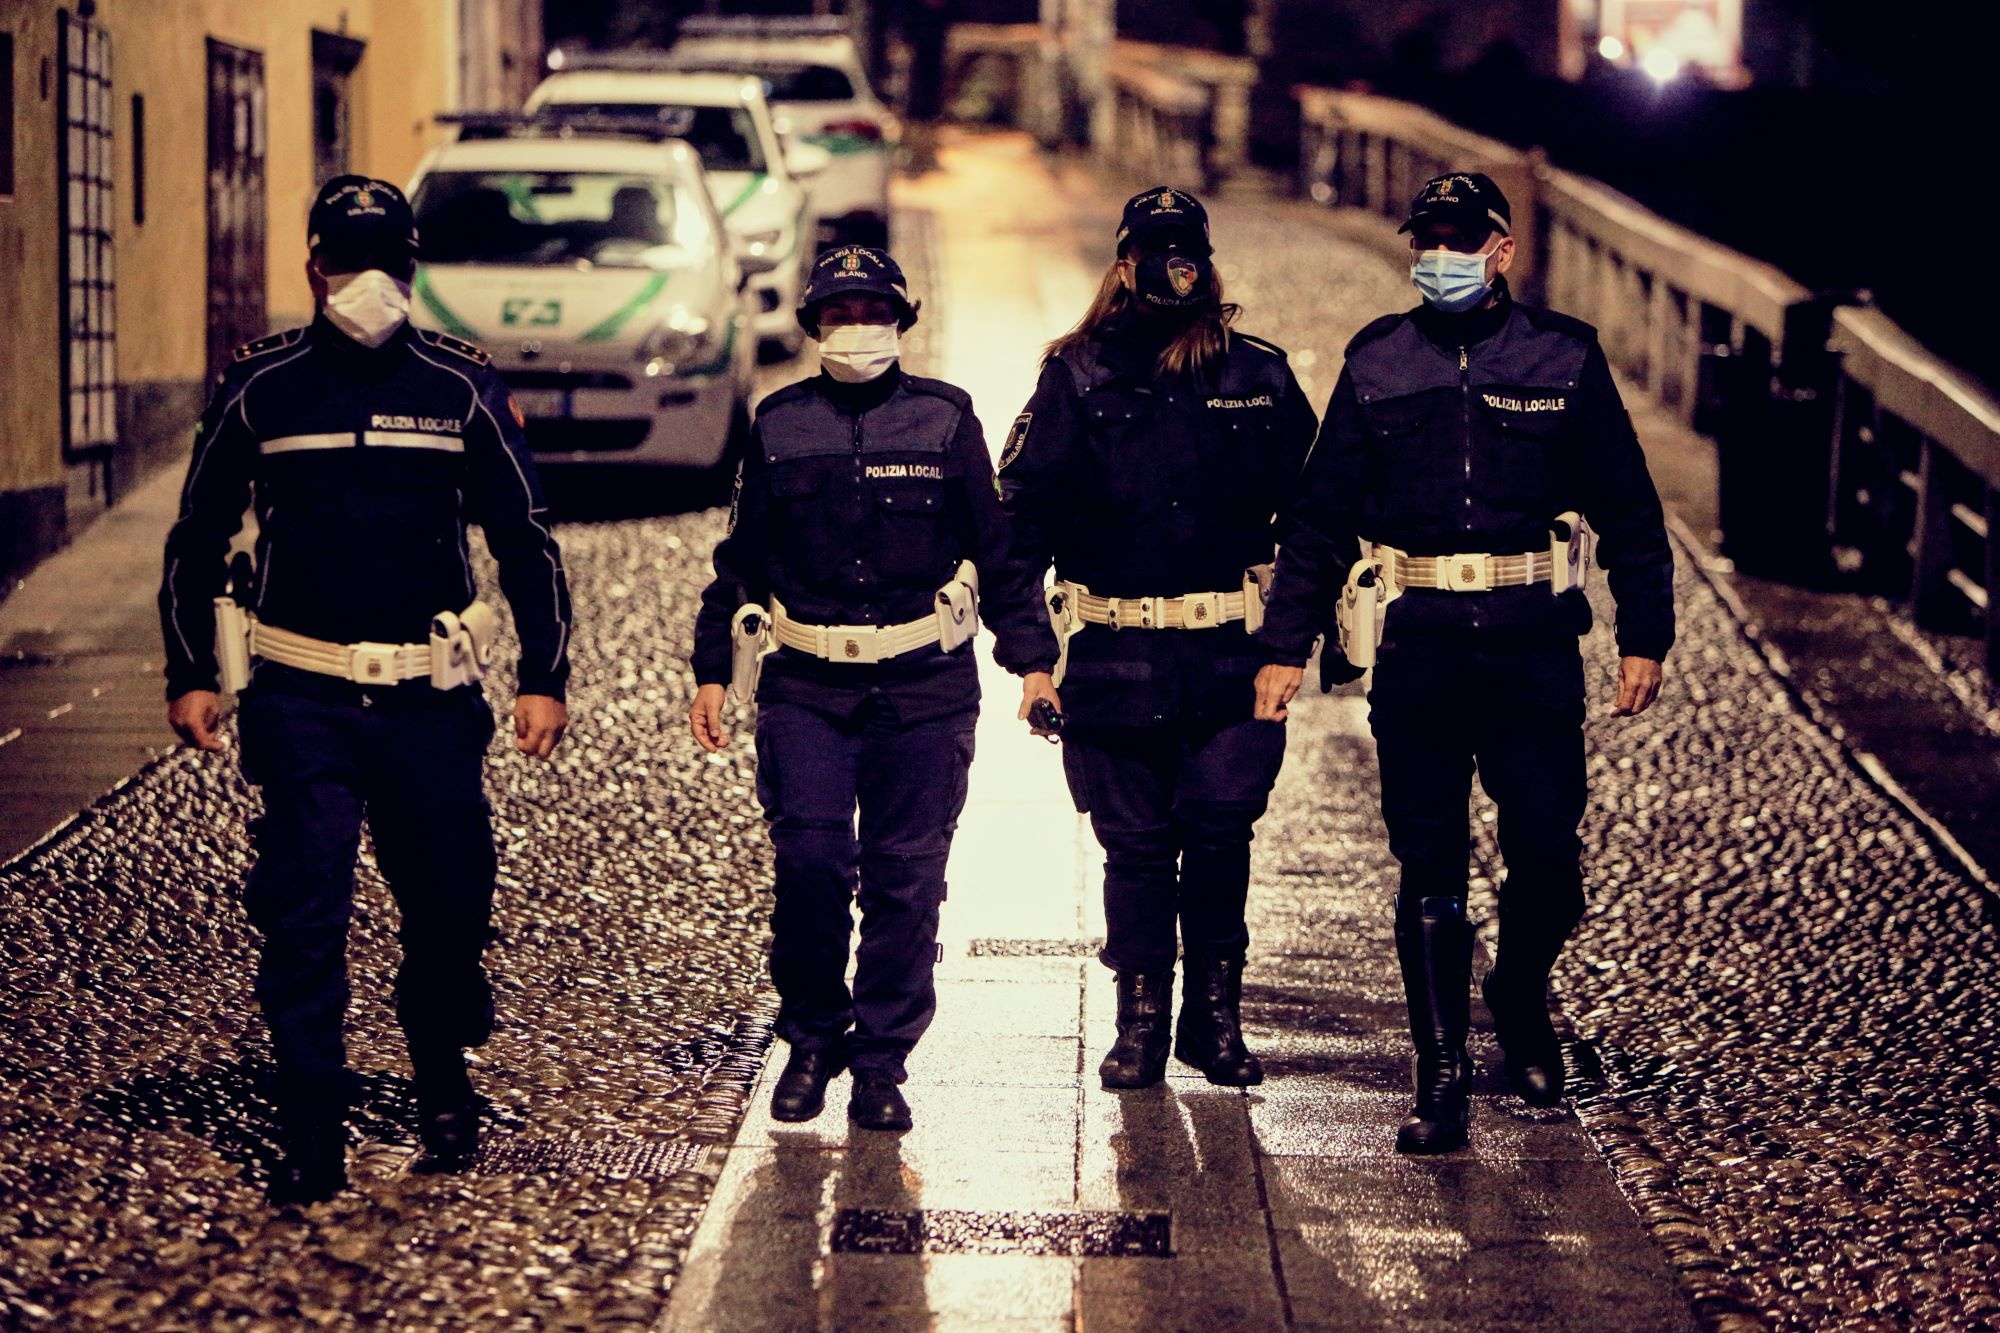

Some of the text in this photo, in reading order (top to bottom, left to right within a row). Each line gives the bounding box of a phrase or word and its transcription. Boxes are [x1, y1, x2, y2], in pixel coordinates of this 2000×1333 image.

[853, 247, 886, 269] LOCALE
[834, 270, 868, 279] MILANO
[1206, 398, 1245, 409] POLIZIA
[1482, 393, 1566, 413] POLIZIA LOCALE
[371, 414, 462, 433] POLIZIA LOCALE
[865, 464, 908, 478] POLIZIA
